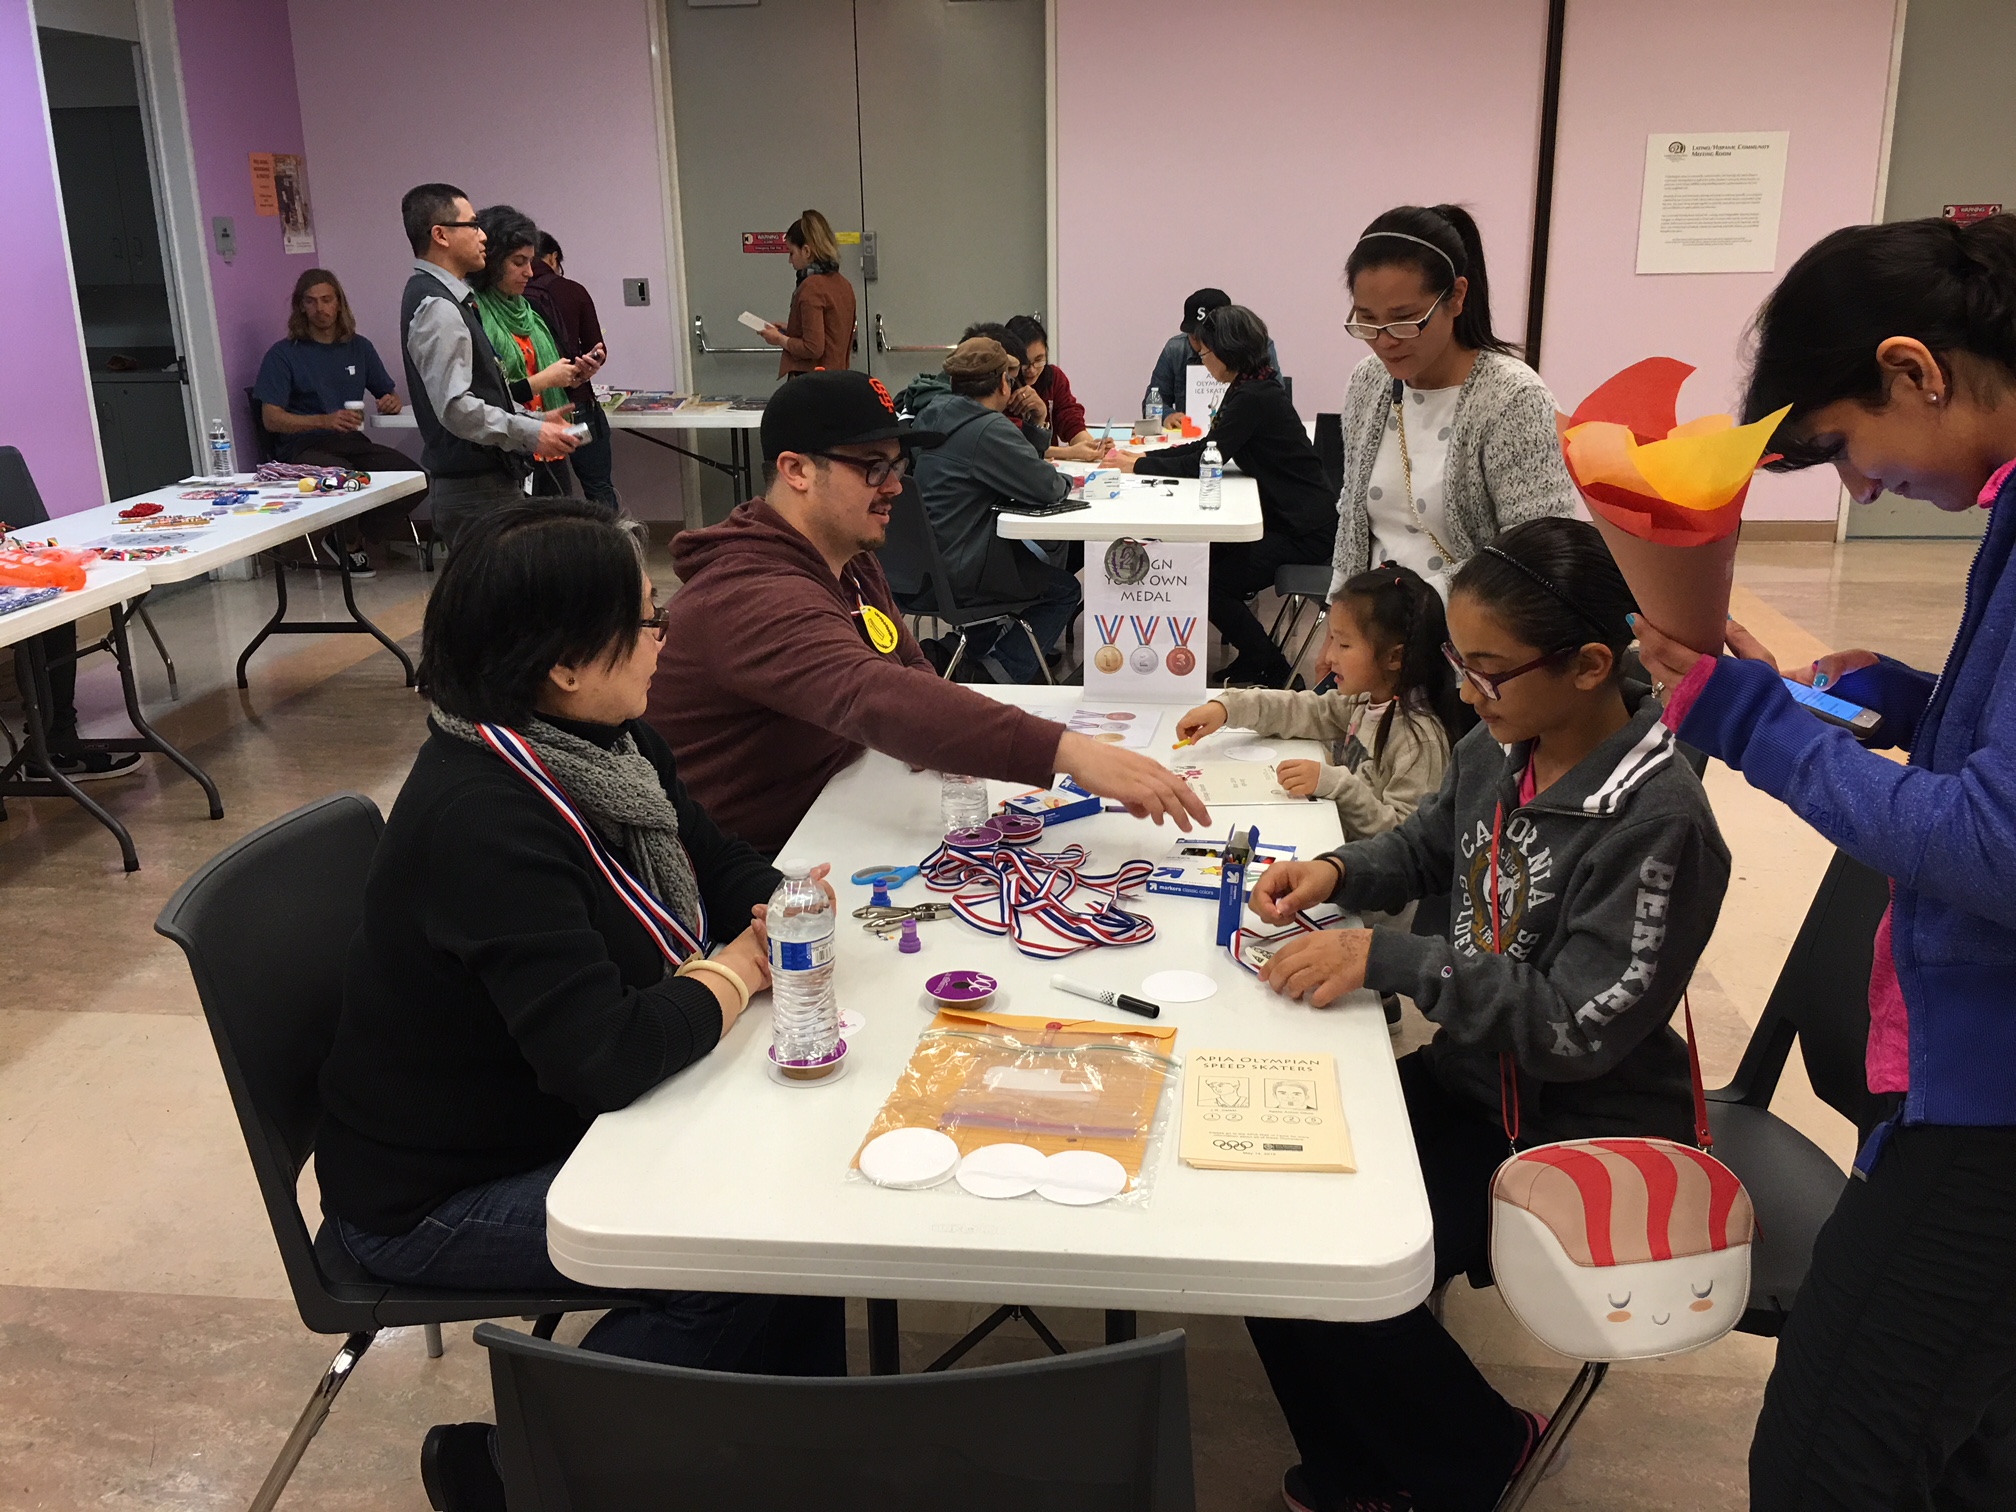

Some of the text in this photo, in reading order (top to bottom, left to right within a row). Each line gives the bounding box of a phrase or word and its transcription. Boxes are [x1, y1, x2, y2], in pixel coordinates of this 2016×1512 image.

[1196, 307, 1206, 321] S
[1149, 575, 1187, 586] OWN
[1120, 590, 1171, 602] MEDAL
[1461, 816, 1556, 913] CAORNIA
[1159, 884, 1182, 893] markers
[1198, 888, 1214, 896] colors
[1546, 855, 1677, 1057] BERKELY
[1240, 1057, 1320, 1065] OLYMPIAN
[1252, 1064, 1313, 1072] SKATERS
